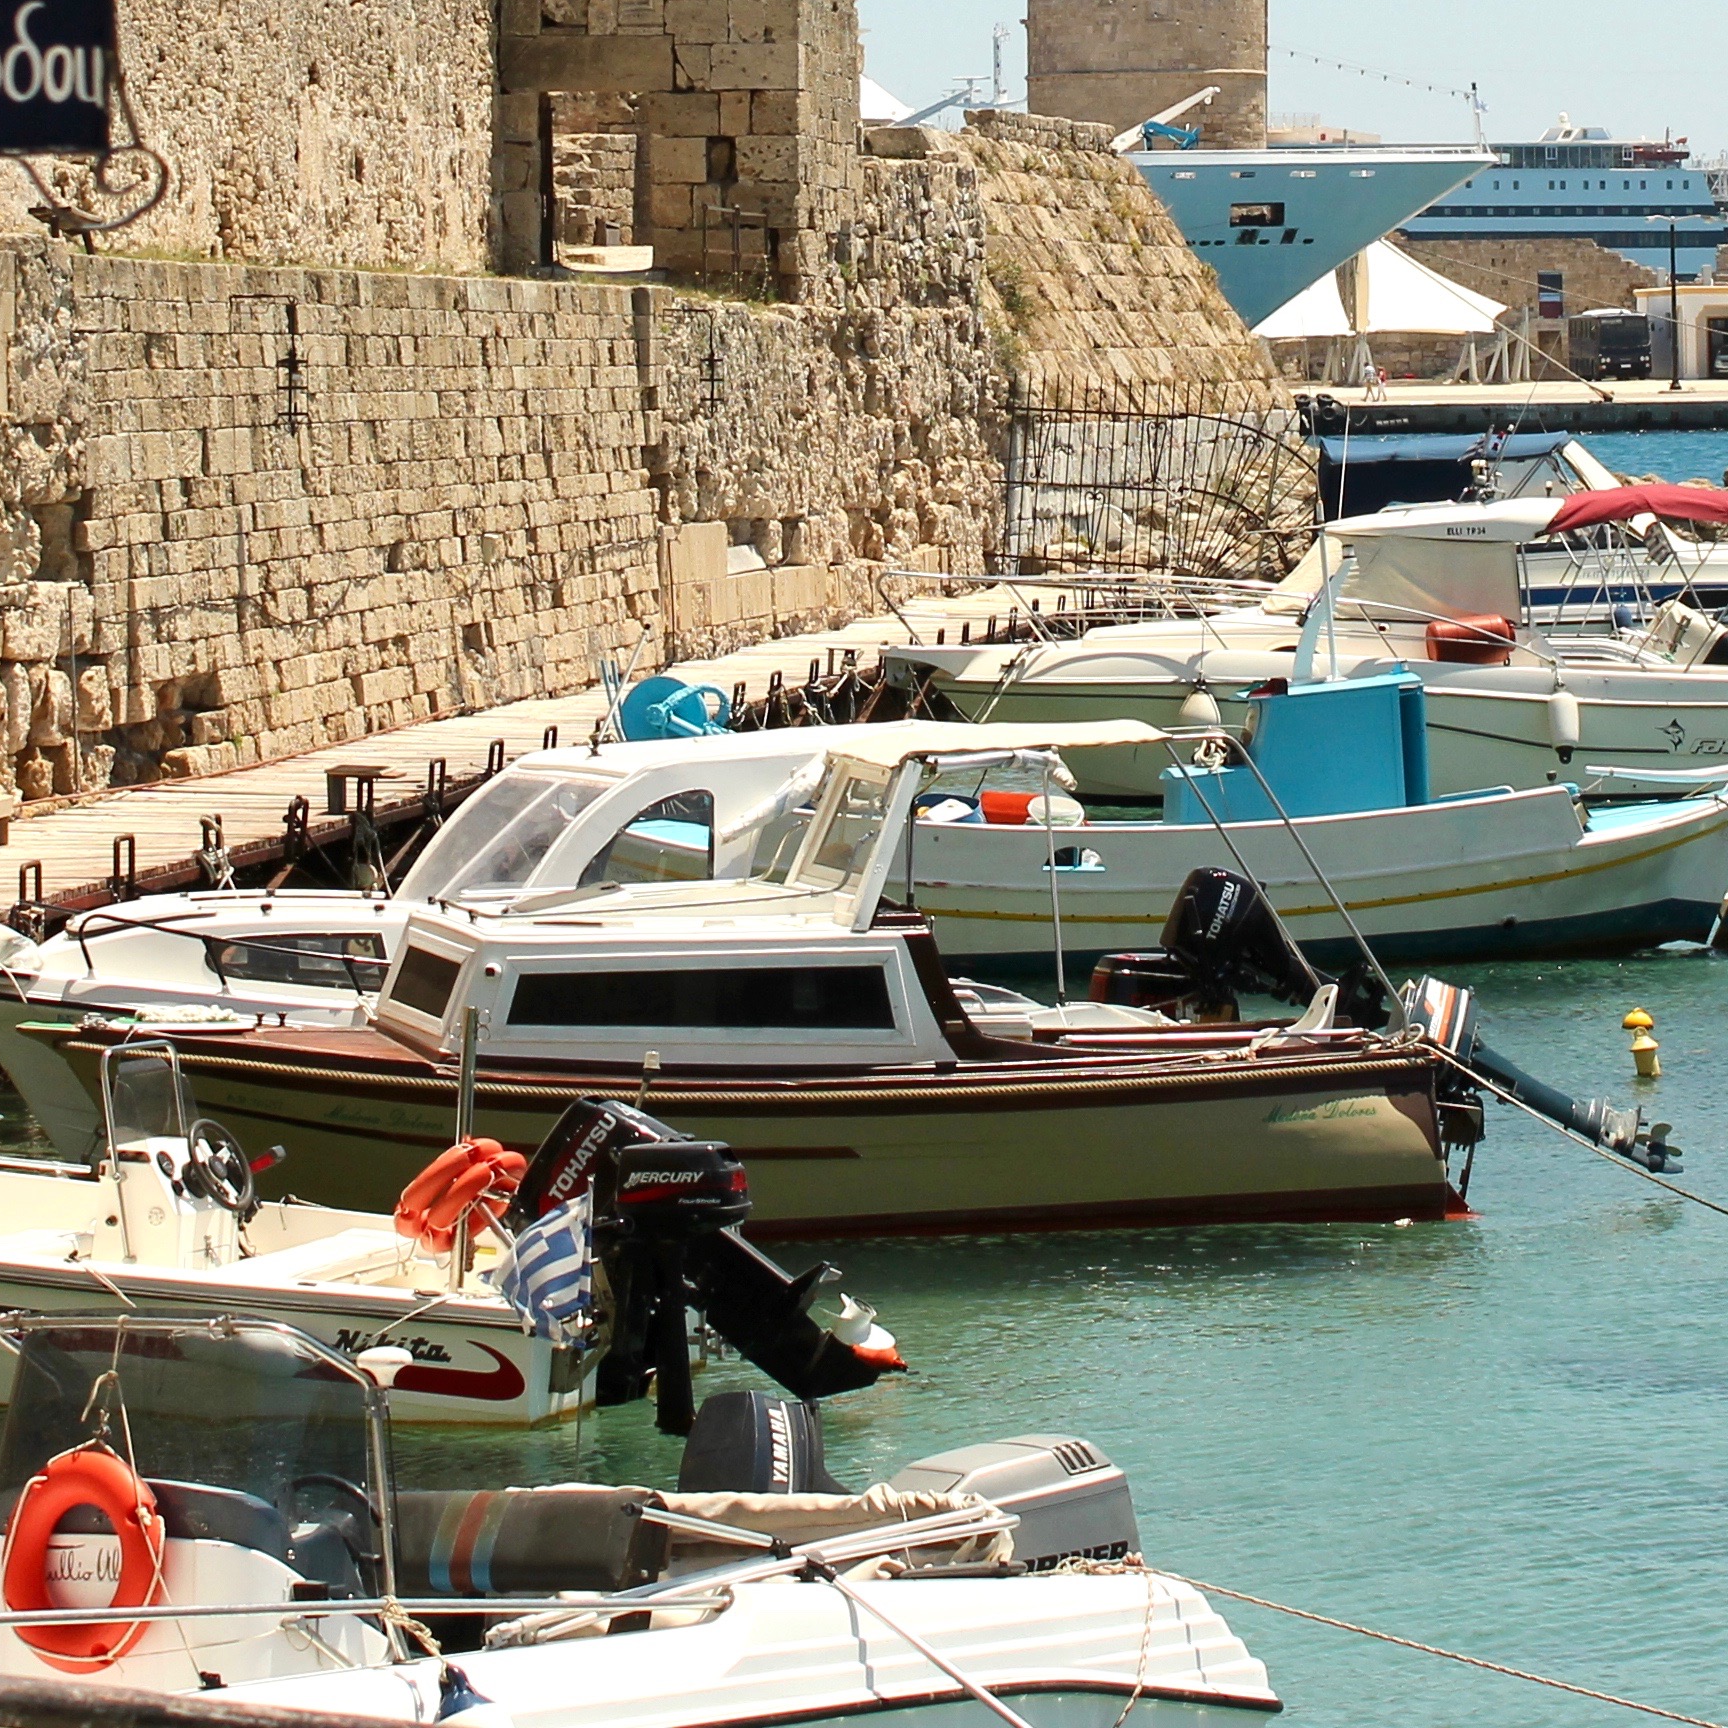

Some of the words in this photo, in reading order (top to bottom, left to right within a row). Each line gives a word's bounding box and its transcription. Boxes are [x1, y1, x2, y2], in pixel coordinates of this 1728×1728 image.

[1206, 881, 1235, 940] TOHATSU
[548, 1112, 617, 1201] TOHATSU
[625, 1171, 705, 1184] MERCURY
[768, 1408, 788, 1483] YAMAHA
